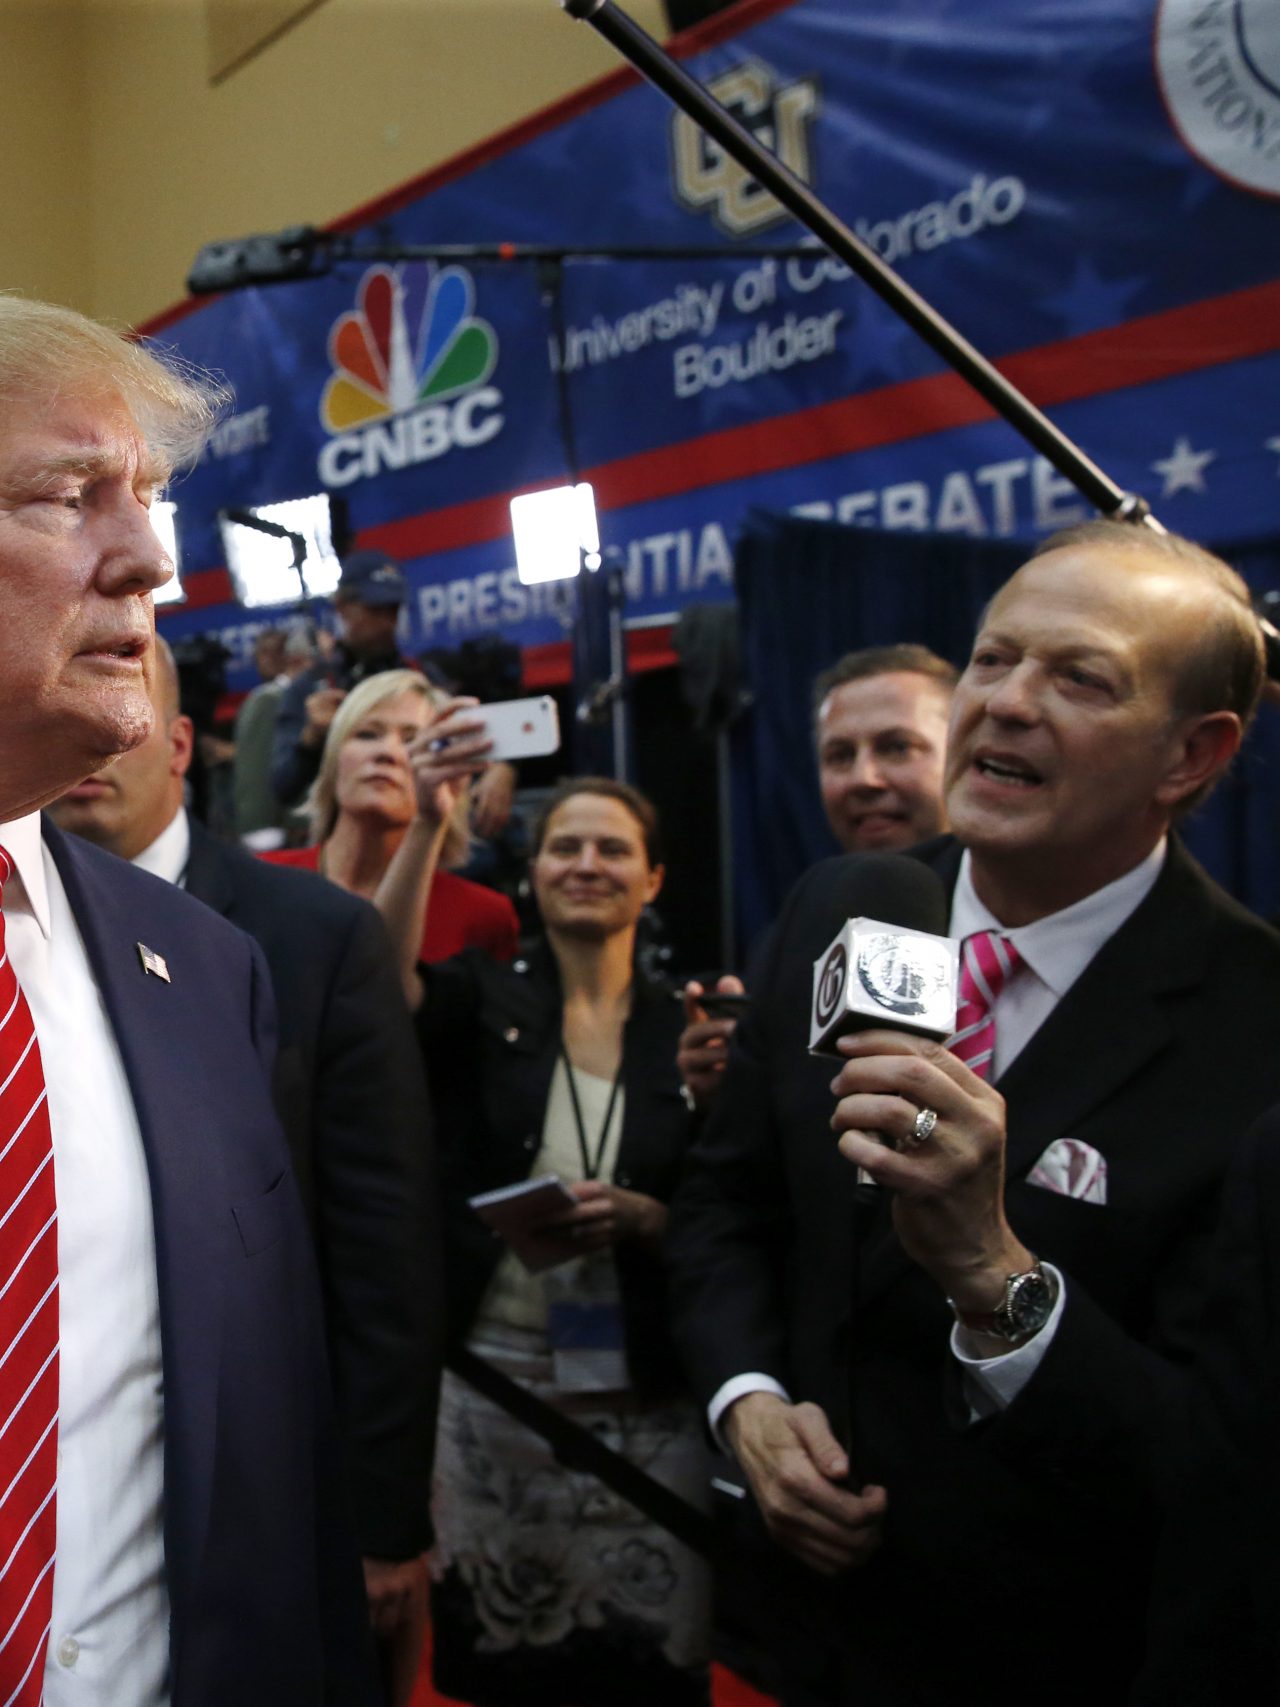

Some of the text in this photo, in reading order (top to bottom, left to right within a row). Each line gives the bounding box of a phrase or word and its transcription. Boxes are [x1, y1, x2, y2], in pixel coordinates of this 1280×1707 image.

[548, 281, 724, 374] University
[733, 254, 777, 313] of
[674, 308, 843, 398] Boulder
[318, 385, 503, 487] CNBC
[789, 454, 1086, 538] EBATE
